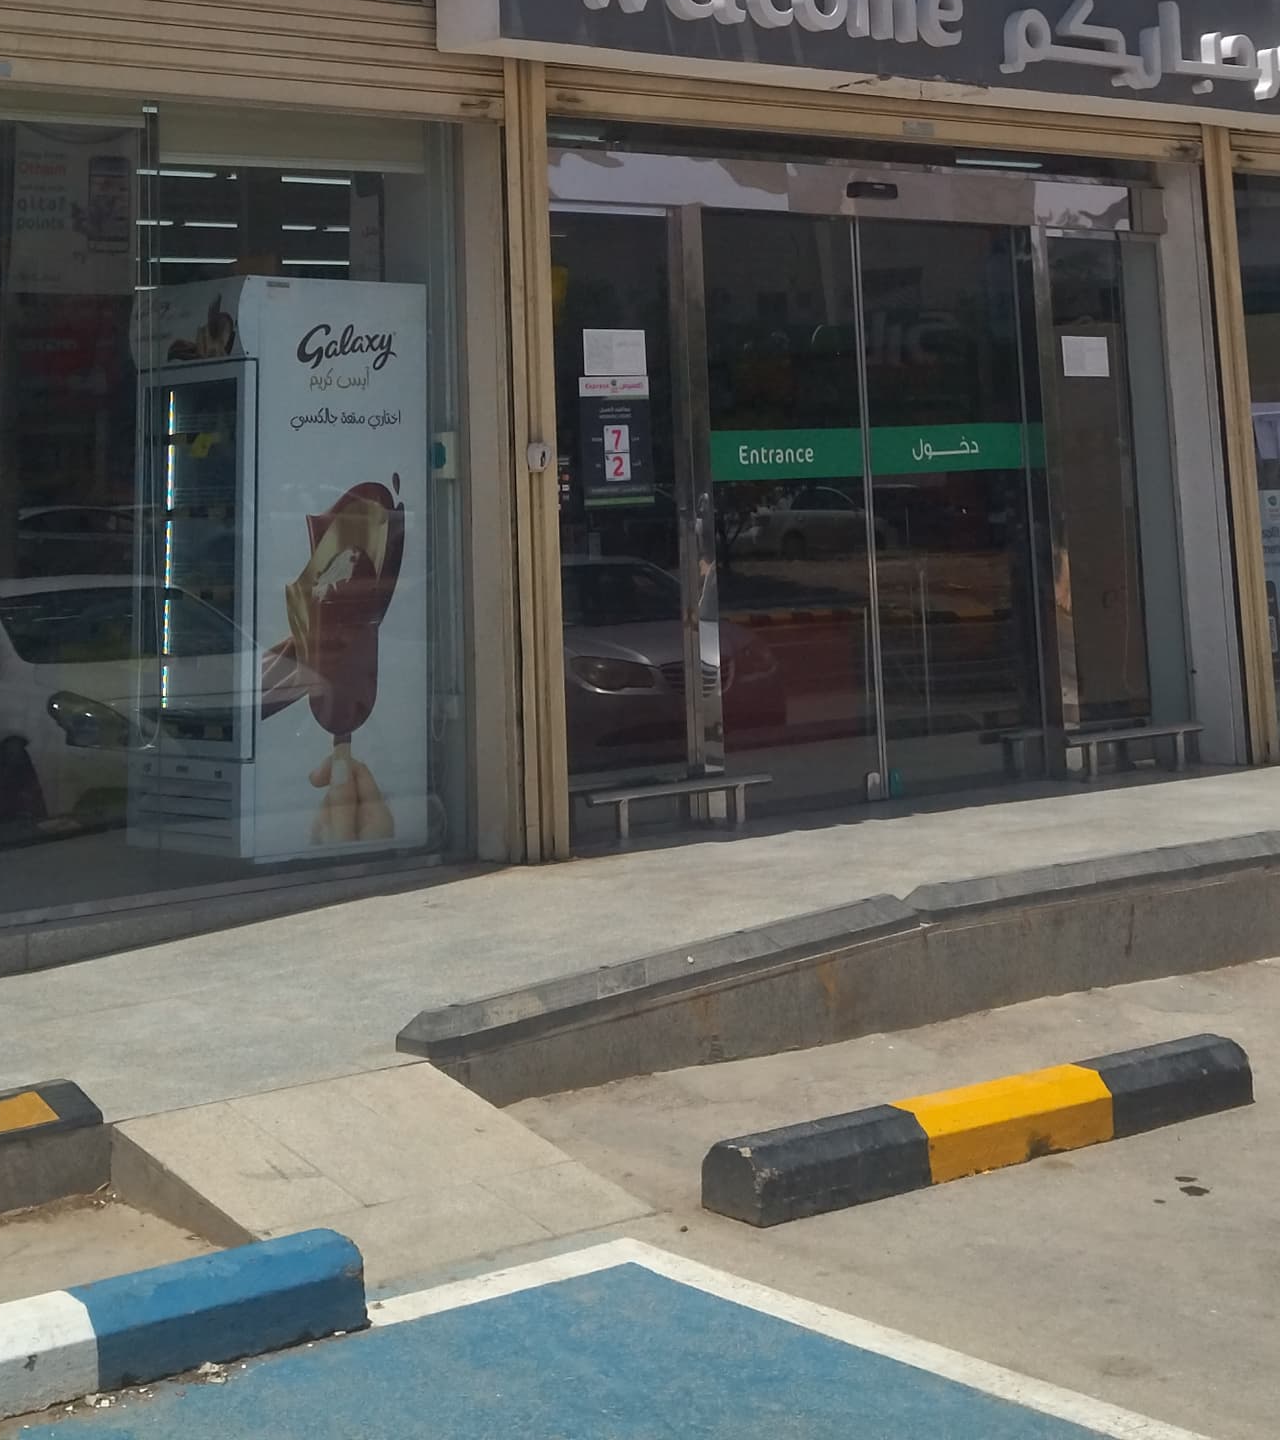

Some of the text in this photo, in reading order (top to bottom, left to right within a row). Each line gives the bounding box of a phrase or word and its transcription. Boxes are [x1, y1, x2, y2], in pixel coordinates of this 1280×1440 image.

[297, 324, 398, 370] Galaxy
[309, 367, 334, 392] كريم
[611, 429, 623, 450] 7
[911, 435, 980, 461] دخول
[612, 455, 625, 477] 2
[738, 445, 815, 465] Entrance
